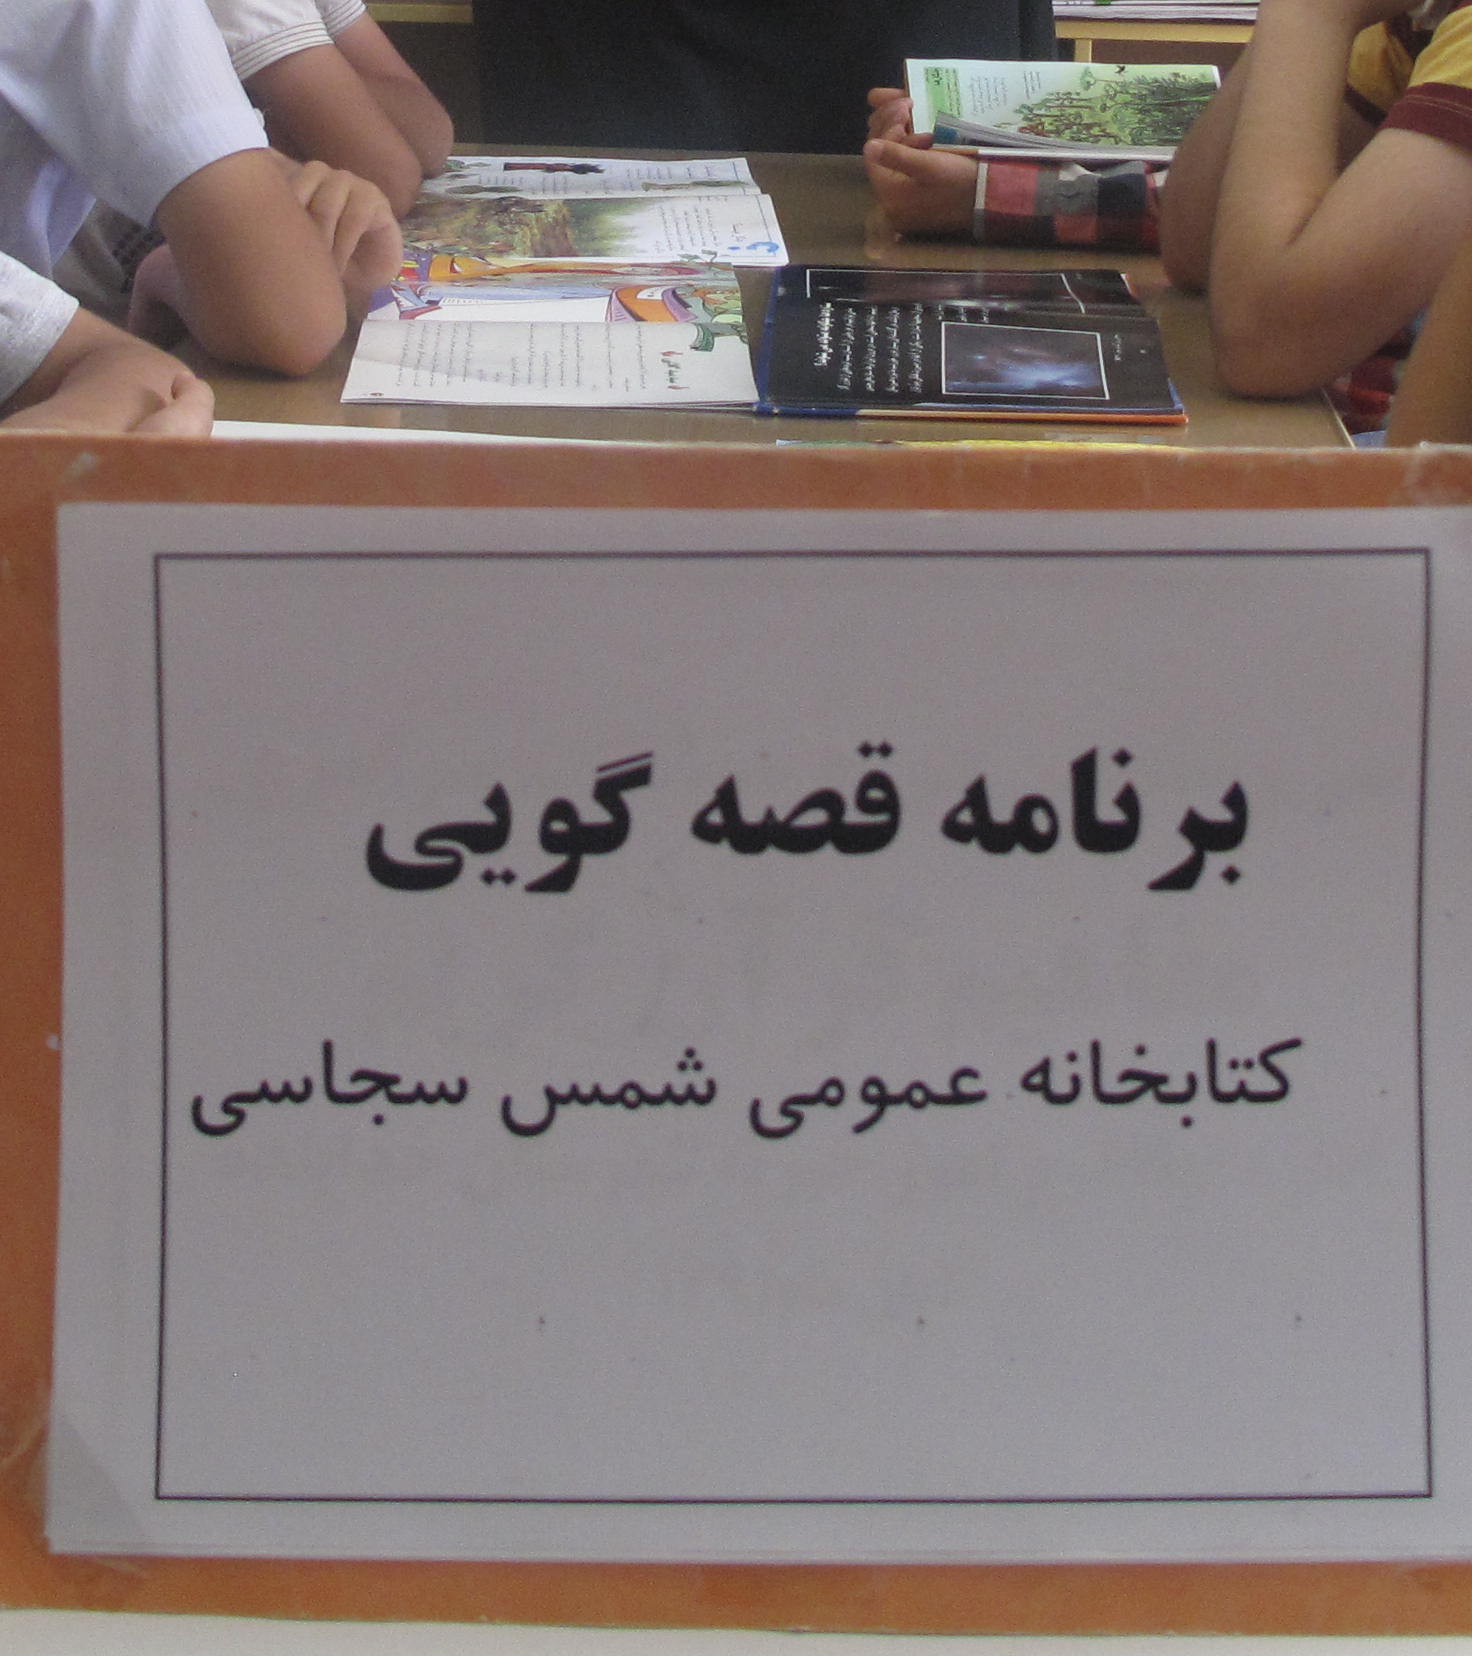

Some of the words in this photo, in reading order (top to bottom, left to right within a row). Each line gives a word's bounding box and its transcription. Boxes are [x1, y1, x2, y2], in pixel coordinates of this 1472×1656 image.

[366, 753, 653, 893] گویی
[691, 741, 901, 856] قصه
[941, 749, 1248, 892] برنامه
[190, 1041, 469, 1138] سجاسی
[501, 1047, 717, 1139] شمس
[748, 1068, 988, 1140] عمومی
[1021, 1037, 1303, 1129] کتابخانه
